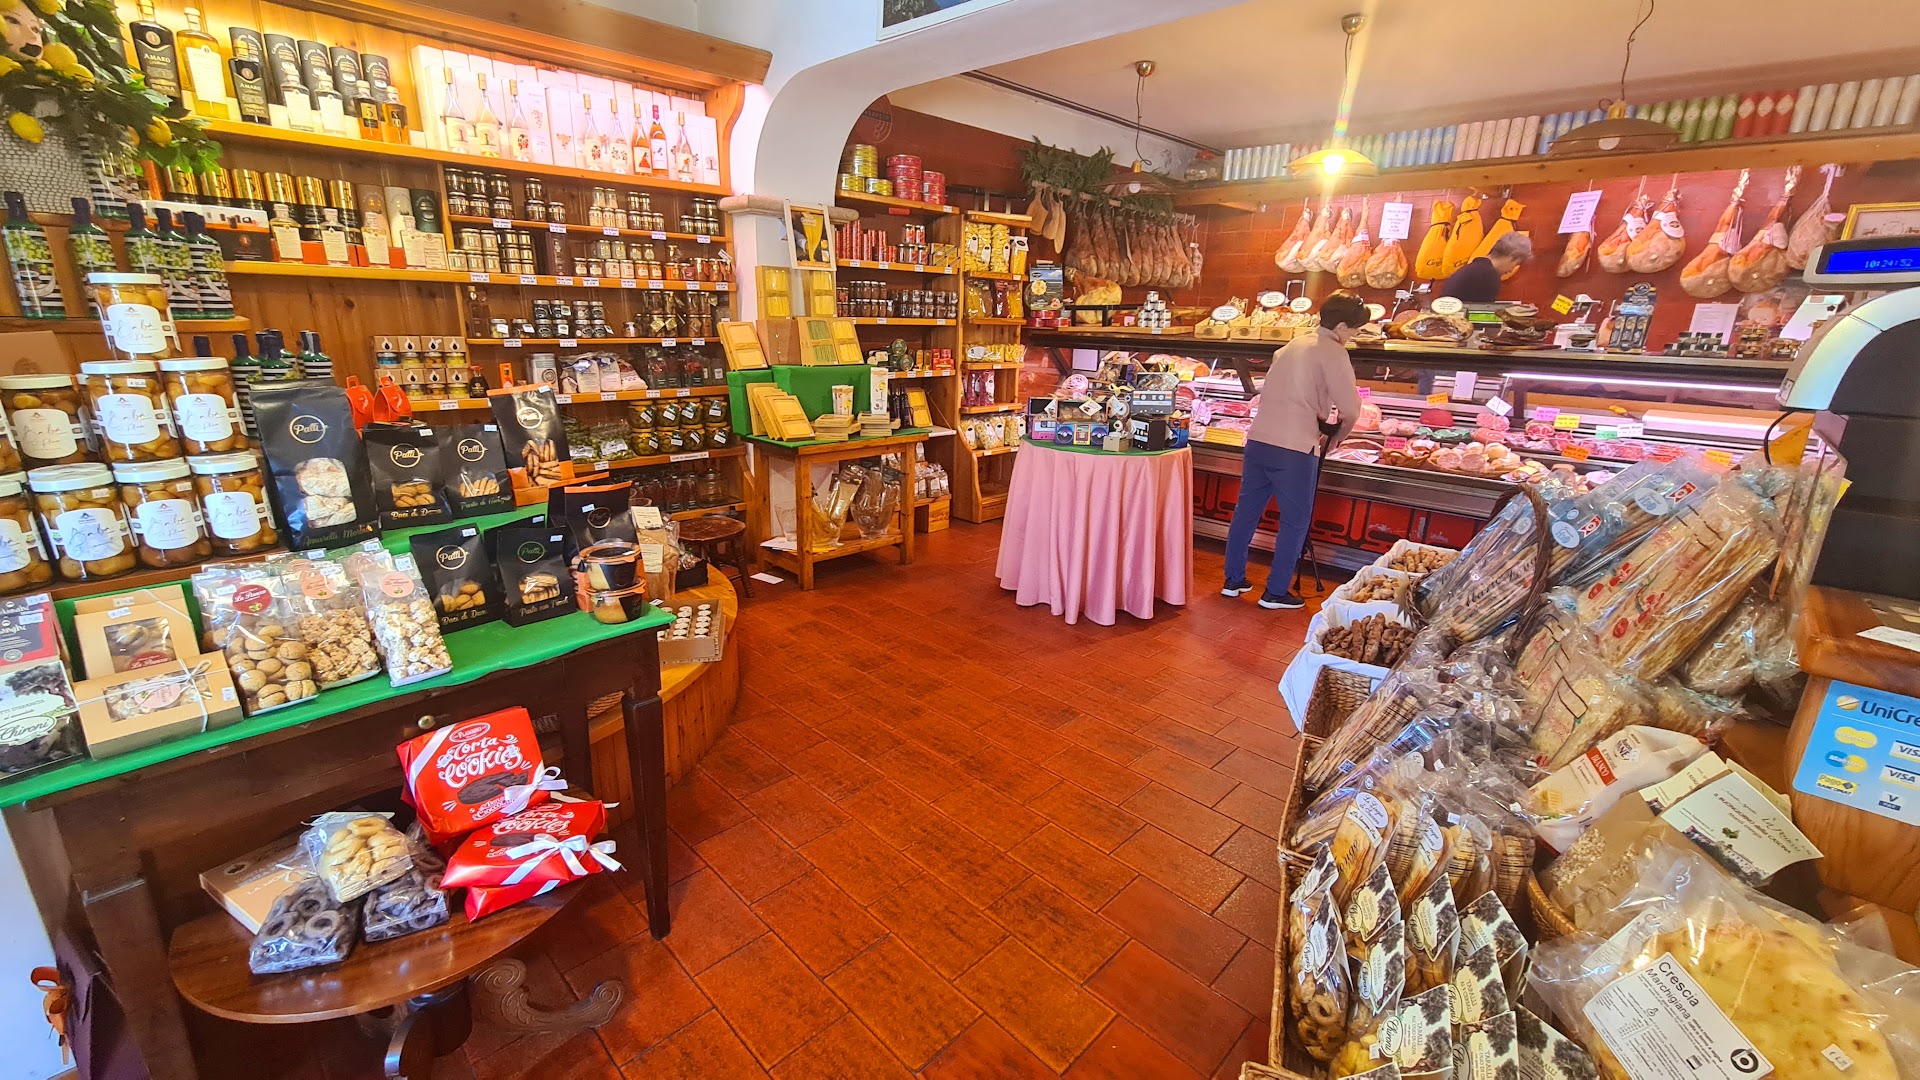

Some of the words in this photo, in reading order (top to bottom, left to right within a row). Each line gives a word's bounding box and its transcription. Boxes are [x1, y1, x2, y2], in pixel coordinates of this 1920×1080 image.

[144, 53, 171, 63] AMARO
[365, 106, 374, 117] 5
[1865, 259, 1913, 268] 10:24:52
[1, 720, 50, 740] Chironi
[445, 735, 503, 760] Torta
[1899, 745, 1920, 759] VIS
[439, 746, 523, 788] Cookies
[1591, 753, 1609, 777] BIANCO
[1889, 769, 1916, 782] VISA
[1820, 774, 1841, 787] Pago
[492, 817, 570, 834] Cookies
[1718, 795, 1754, 825] BUONGIORNO
[1753, 822, 1768, 835] della
[1767, 834, 1791, 854] CASCINA
[1350, 904, 1361, 930] Chironi
[1362, 962, 1371, 997] Chironi
[1657, 958, 1701, 1008] Crescia
[1448, 987, 1461, 1022] Chironi
[1464, 979, 1478, 1006] TARALLI
[1644, 965, 1692, 1021] Marchigiana
[1385, 1019, 1397, 1052] Chironi
[1529, 1052, 1557, 1077] TARALLI
